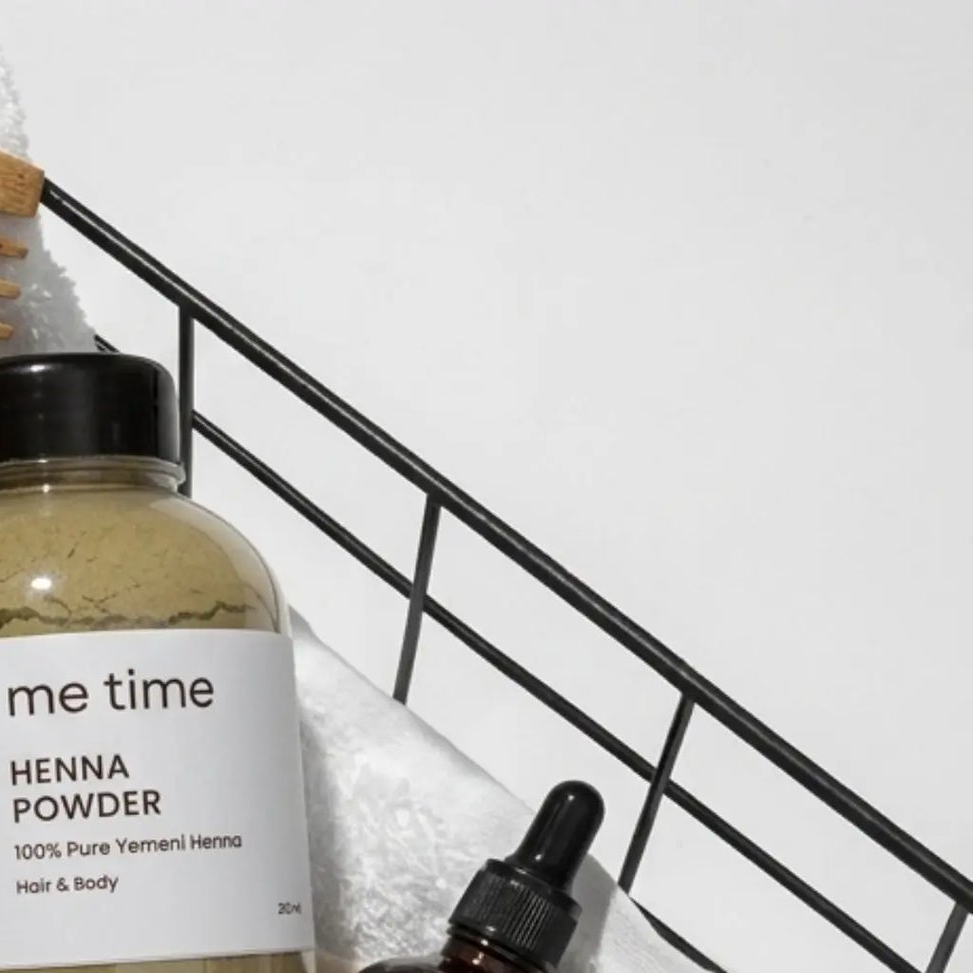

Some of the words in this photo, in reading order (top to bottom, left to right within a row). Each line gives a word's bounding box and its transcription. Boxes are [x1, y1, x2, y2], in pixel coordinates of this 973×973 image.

[8, 683, 88, 716] me
[104, 669, 214, 710] time
[11, 754, 129, 786] HENNA
[14, 790, 160, 823] POWDER
[15, 843, 62, 860] 100%
[67, 842, 110, 856] Pure
[190, 835, 242, 849] Henna
[17, 879, 51, 893] Hair
[56, 877, 69, 892] &
[74, 875, 118, 893] Body
